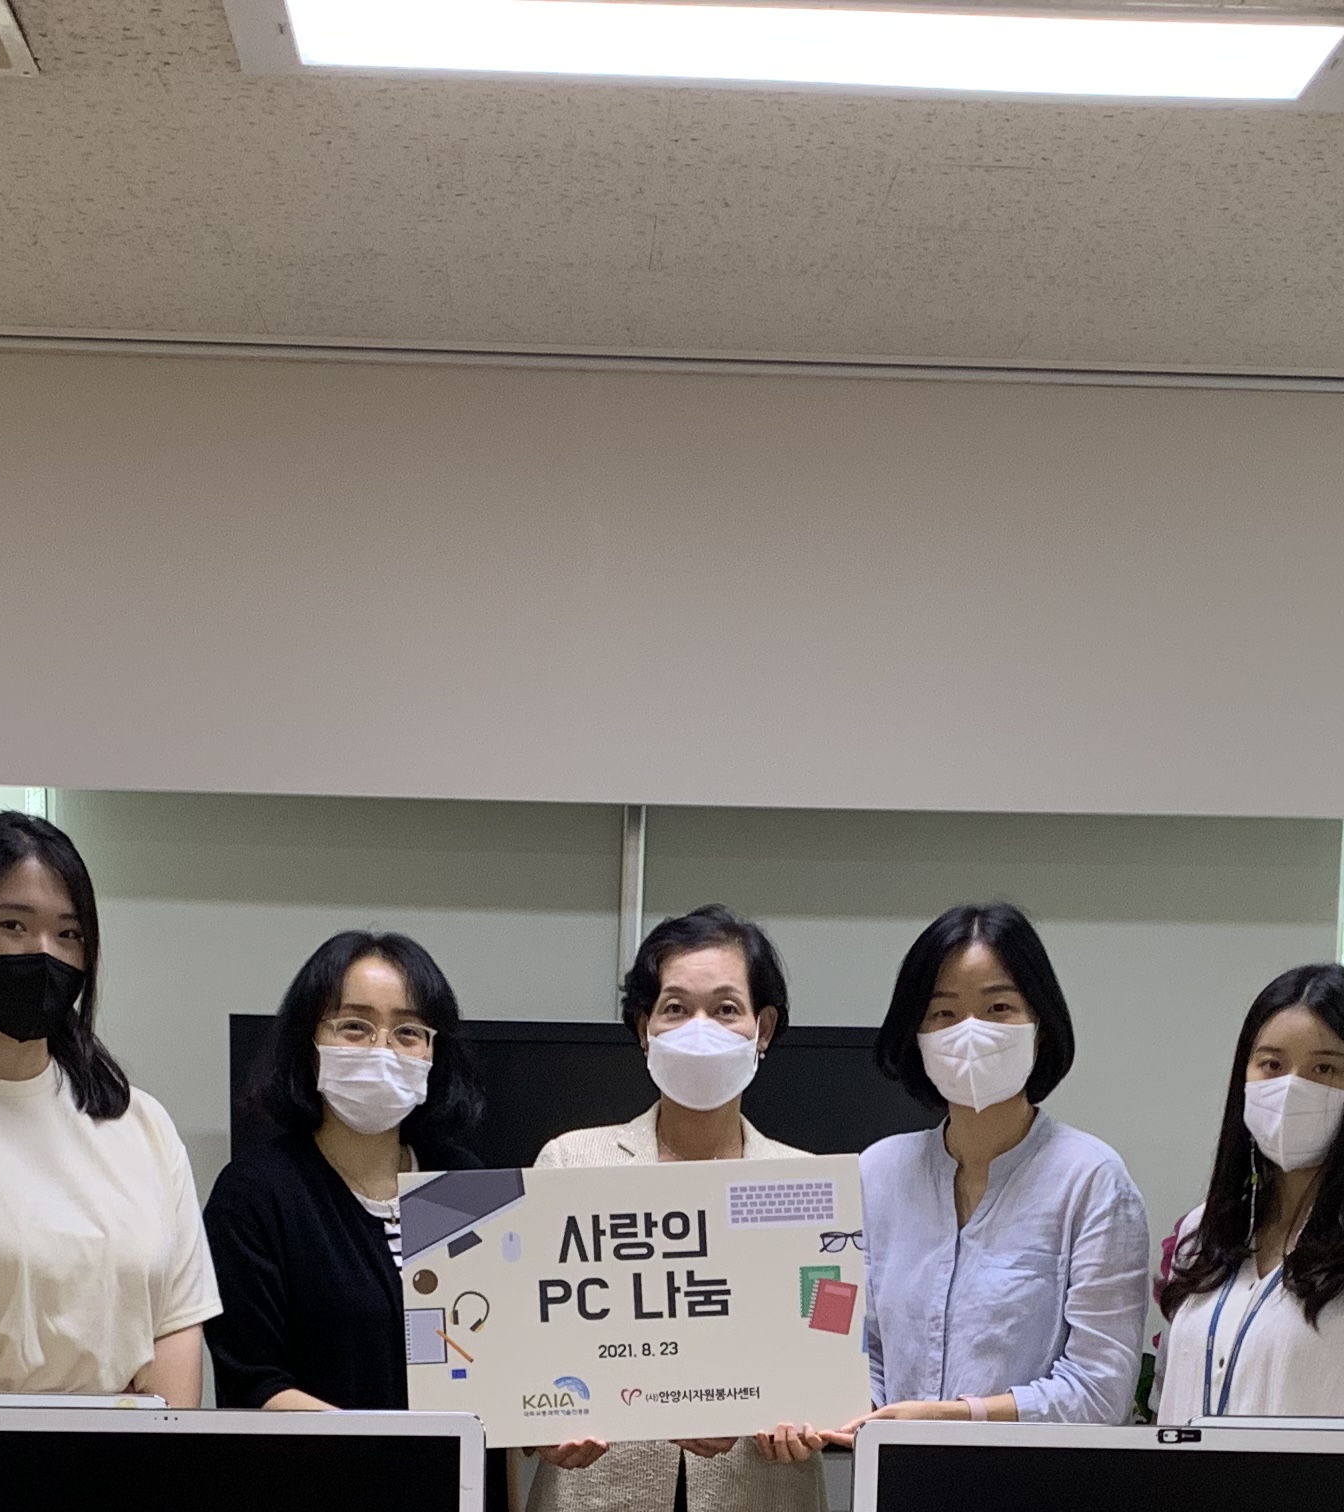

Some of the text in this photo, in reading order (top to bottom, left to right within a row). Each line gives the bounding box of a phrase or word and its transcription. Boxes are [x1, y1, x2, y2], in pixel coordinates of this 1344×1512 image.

[558, 1209, 708, 1264] 사랑의
[538, 1269, 732, 1323] PC 나눔
[598, 1341, 679, 1359] 2021. 8. 23
[522, 1392, 575, 1409] KAIA
